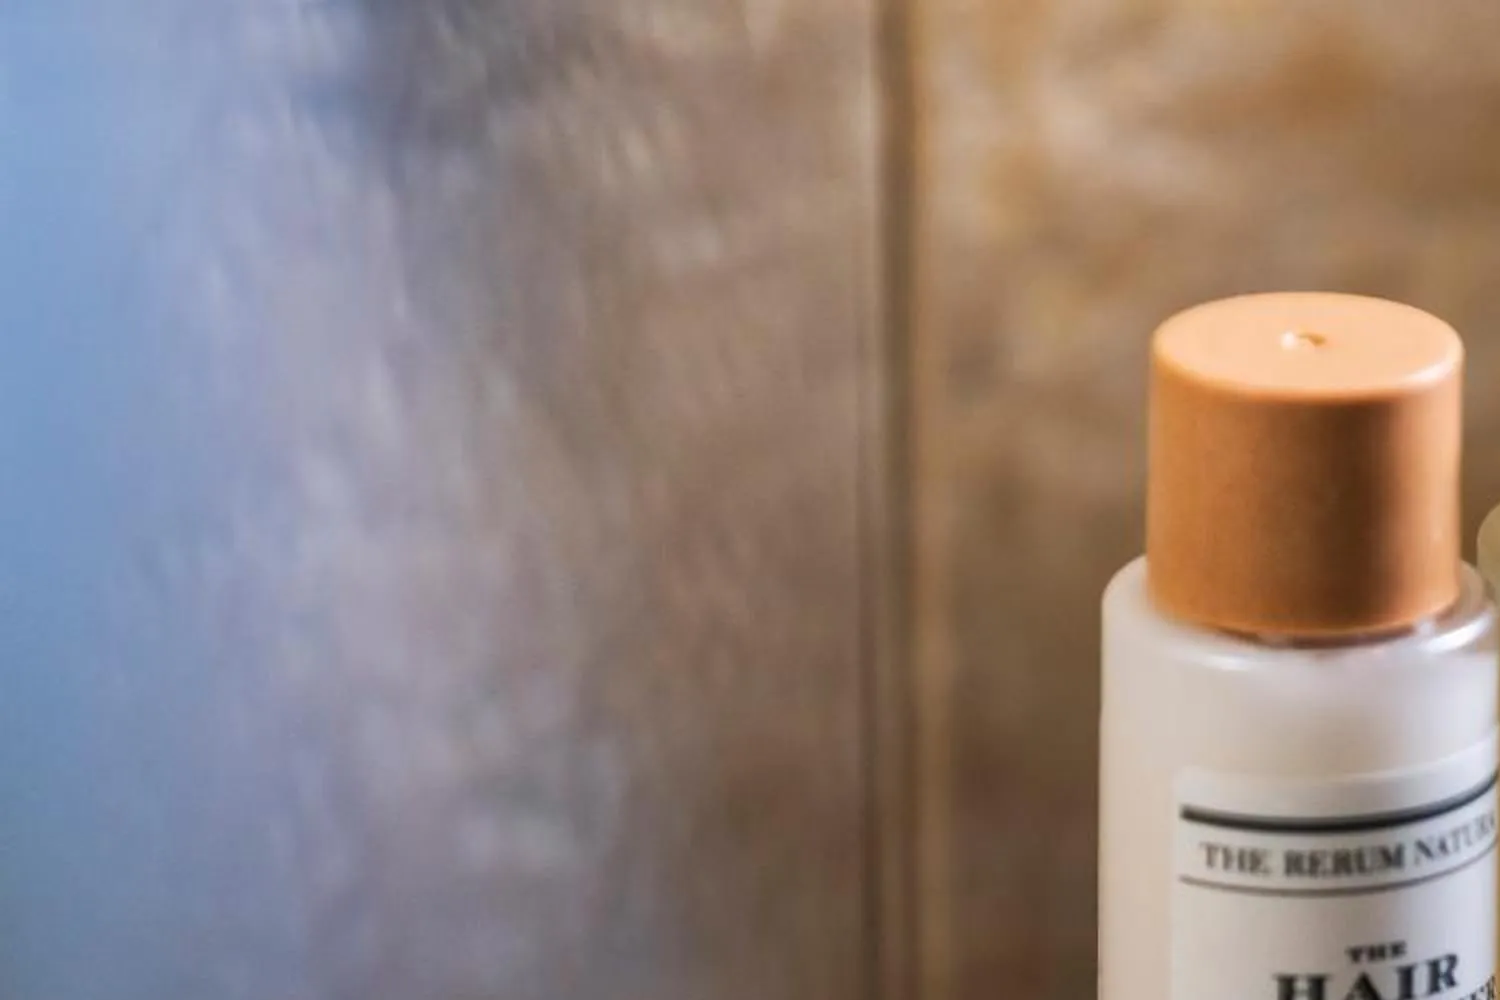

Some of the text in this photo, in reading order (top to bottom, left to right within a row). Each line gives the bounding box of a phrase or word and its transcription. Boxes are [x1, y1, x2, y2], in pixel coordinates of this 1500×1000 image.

[1200, 842, 1272, 875] THE
[1284, 845, 1406, 878] RERUM
[1346, 942, 1408, 964] THE
